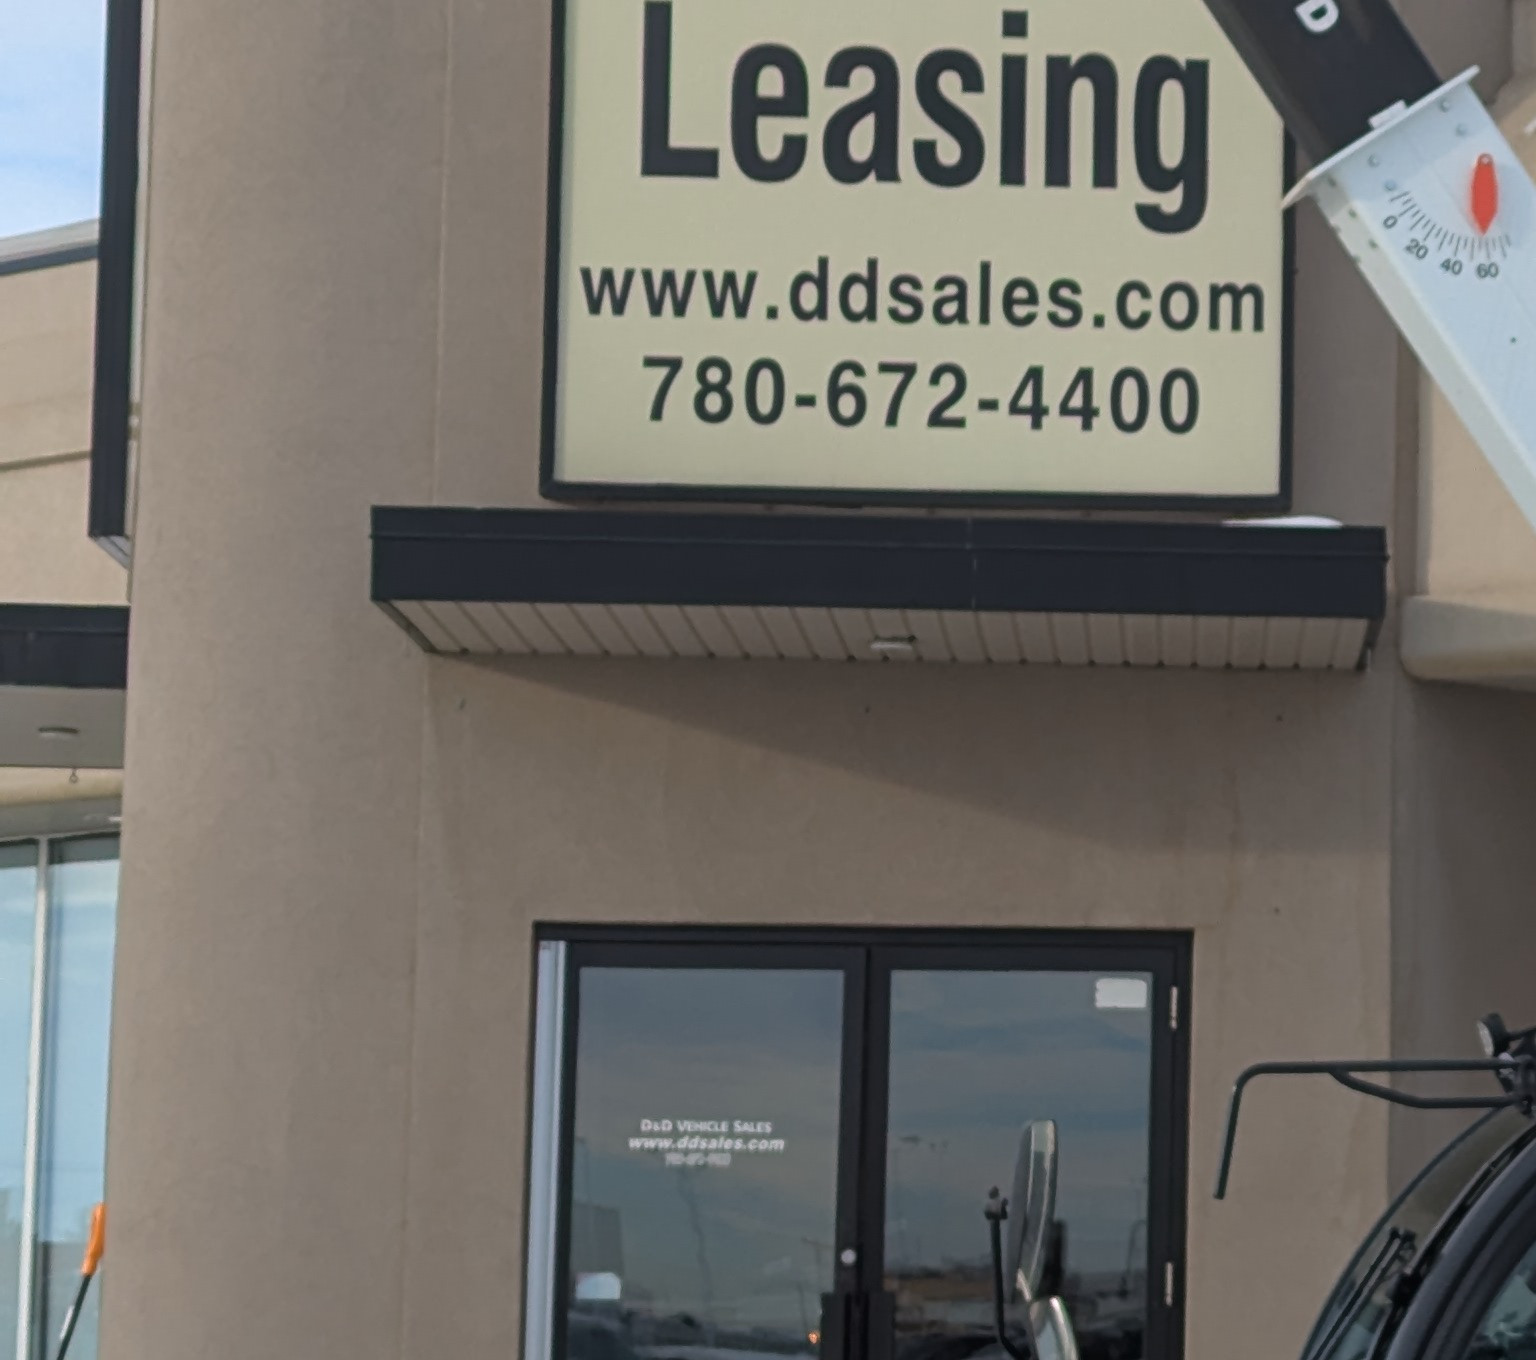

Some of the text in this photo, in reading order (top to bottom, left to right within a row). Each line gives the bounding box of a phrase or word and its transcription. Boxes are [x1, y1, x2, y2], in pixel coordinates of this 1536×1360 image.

[639, 0, 1211, 235] Leasing
[1383, 215, 1399, 230] 0
[1404, 237, 1430, 261] 20
[1440, 256, 1464, 276] 40
[1475, 261, 1500, 280] 60
[580, 256, 1266, 333] www.ddsales.com
[642, 355, 1202, 435] 780-672-4400
[627, 1135, 786, 1152] www.ddsales.com
